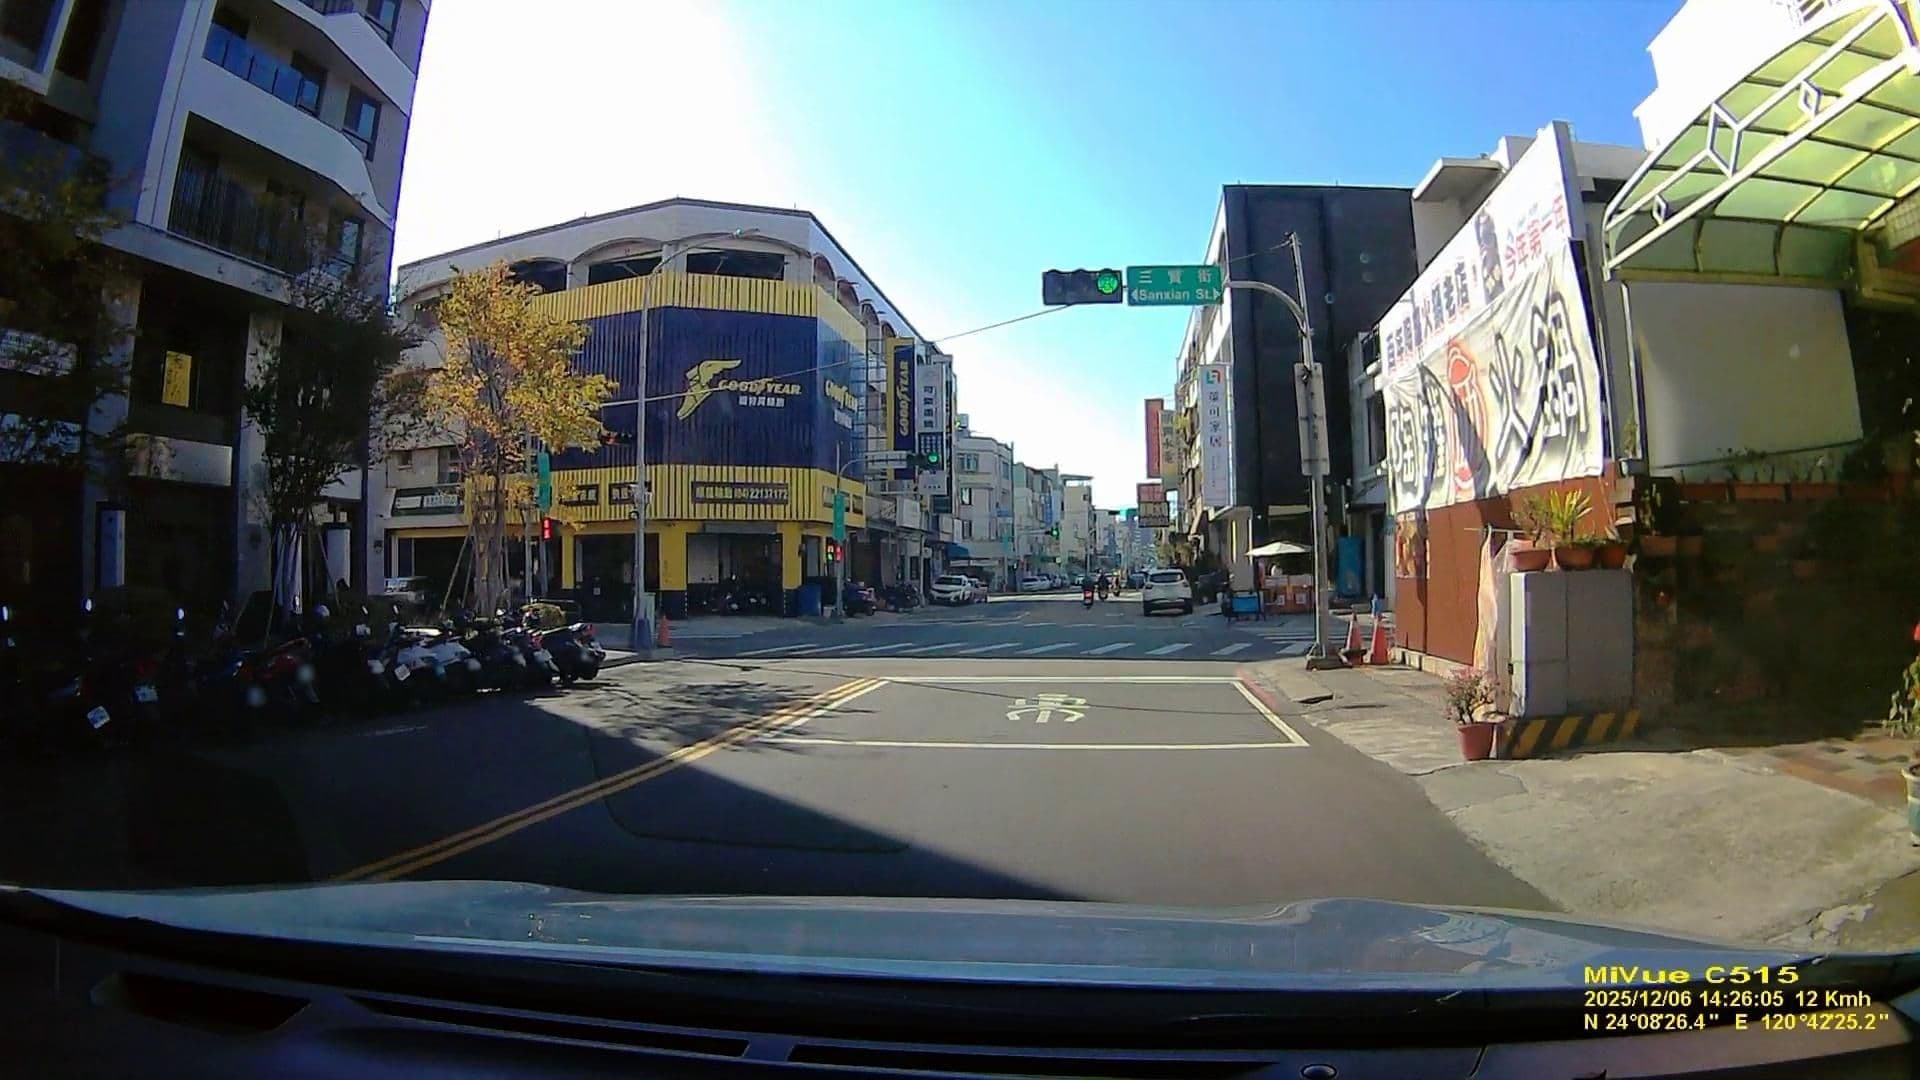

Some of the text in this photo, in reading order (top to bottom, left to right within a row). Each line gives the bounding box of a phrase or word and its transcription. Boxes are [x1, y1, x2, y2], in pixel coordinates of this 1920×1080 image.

[1139, 288, 1190, 301] Sanxian
[718, 377, 802, 396] GOODYEAR
[895, 360, 911, 438] GOODYEAR
